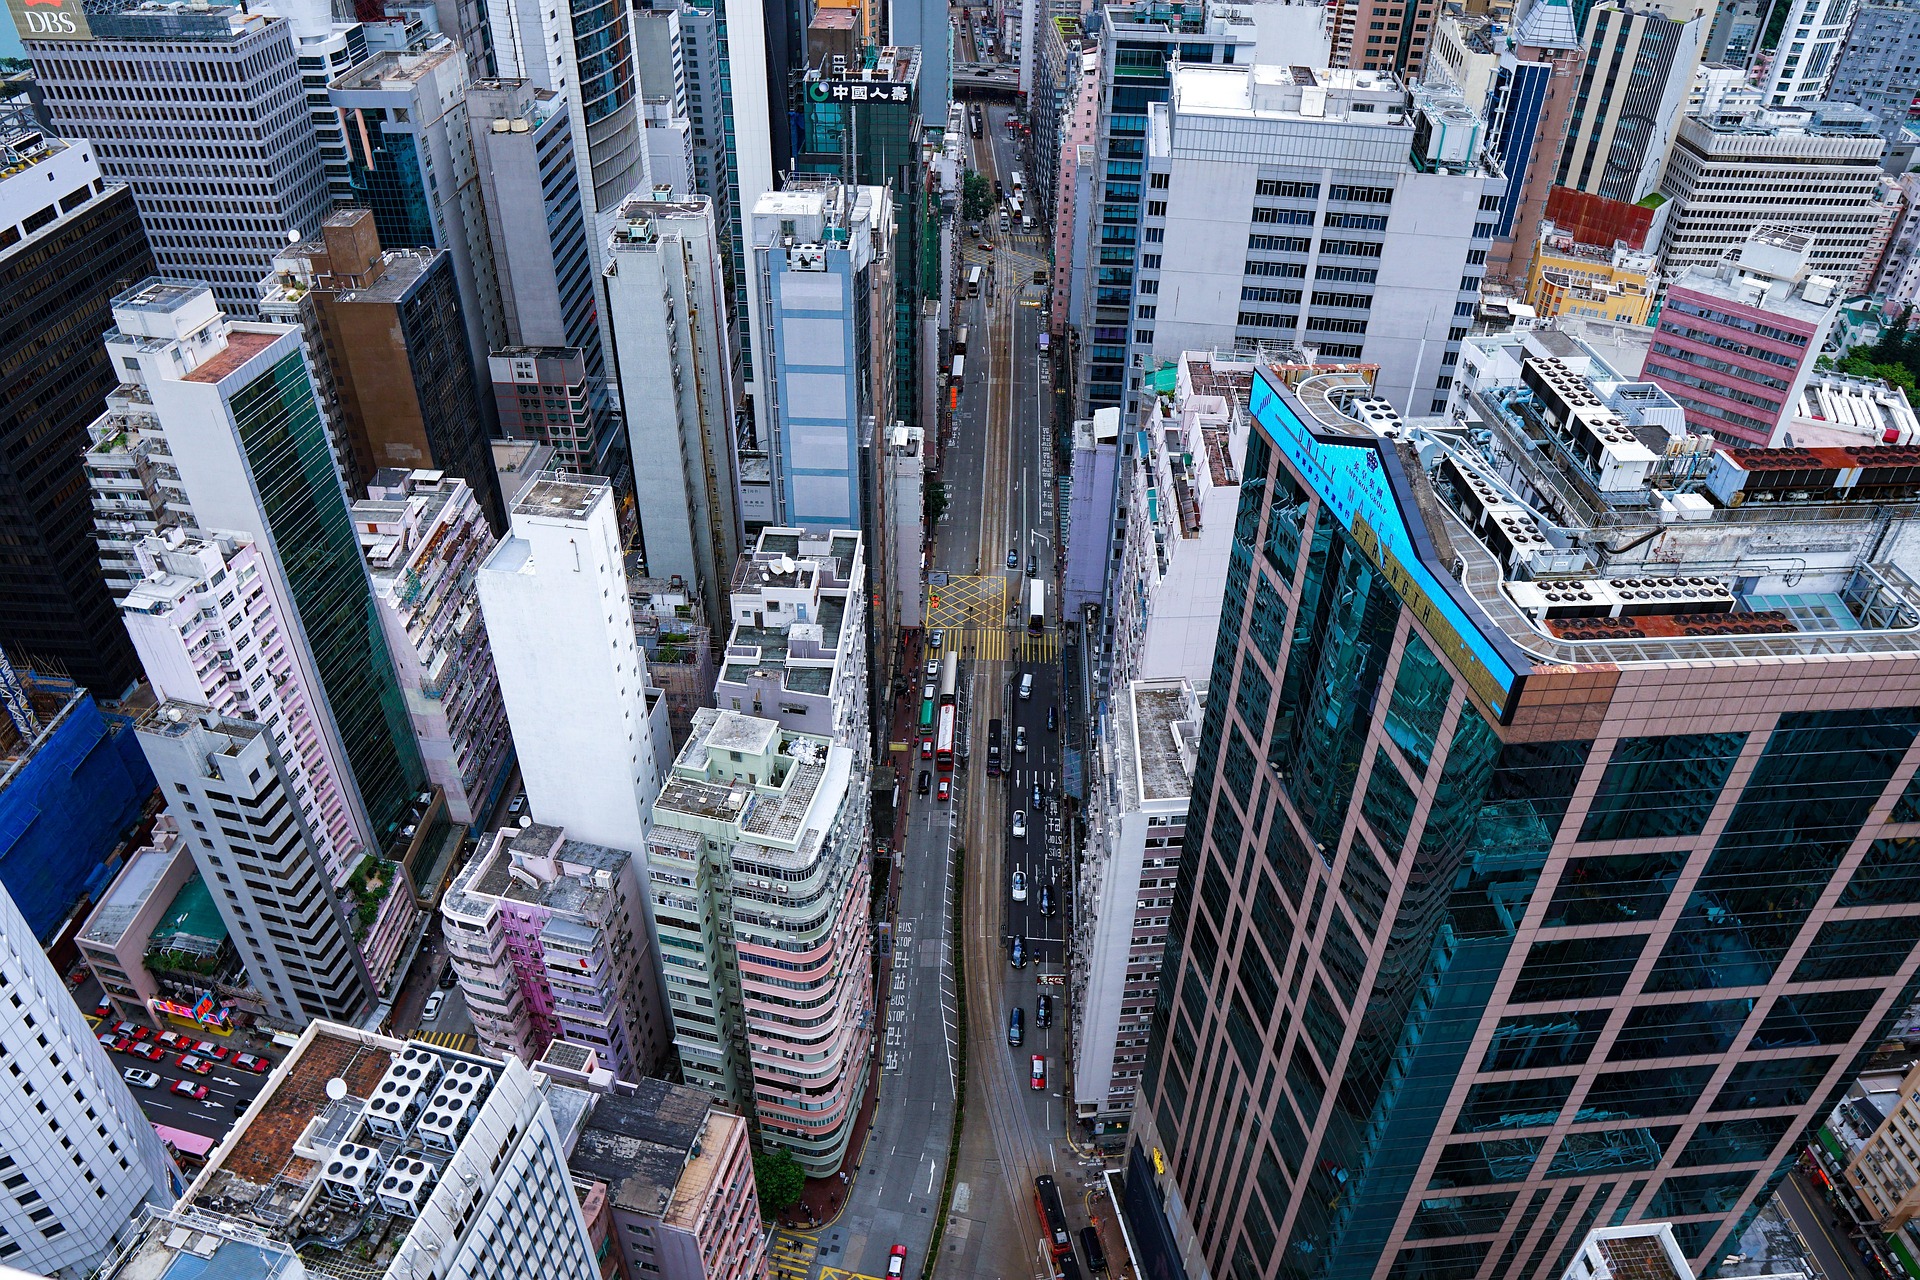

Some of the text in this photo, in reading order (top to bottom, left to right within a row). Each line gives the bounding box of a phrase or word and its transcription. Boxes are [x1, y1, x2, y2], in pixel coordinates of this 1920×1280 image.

[24, 11, 77, 34] DBS
[832, 84, 908, 102] 中國人壽
[1298, 427, 1337, 481] UNITY
[1347, 485, 1394, 549] MAKES
[1345, 465, 1388, 515] EMPEROR GROUP
[1353, 520, 1432, 621] STRENGTH
[1048, 817, 1061, 832] 巴士
[1047, 834, 1063, 845] STOP
[1048, 847, 1062, 858] BUS
[898, 922, 912, 933] BUS
[895, 936, 913, 947] STOP
[894, 951, 910, 968] 巴士
[893, 972, 906, 990] 站
[890, 994, 906, 1006] BUS
[887, 1010, 906, 1022] STOP
[886, 1026, 902, 1046] 巴士
[885, 1050, 899, 1070] 站
